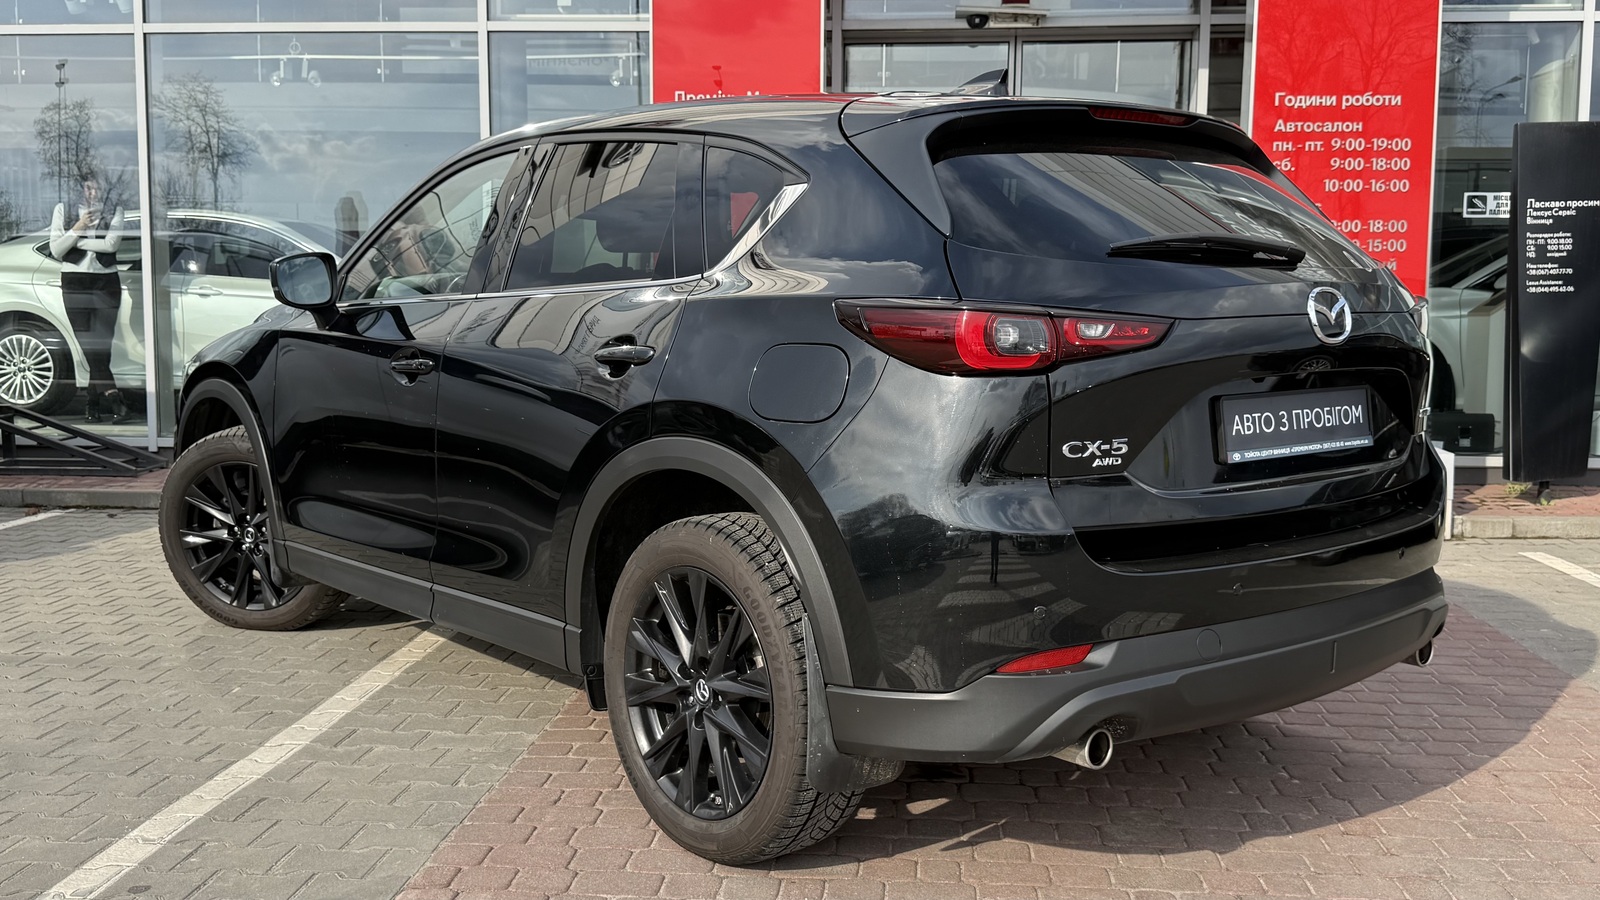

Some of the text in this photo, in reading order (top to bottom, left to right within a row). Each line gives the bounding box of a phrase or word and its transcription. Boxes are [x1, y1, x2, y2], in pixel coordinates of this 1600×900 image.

[1274, 92, 1402, 110] Години роботи
[1274, 119, 1363, 132] Автосалон
[1331, 138, 1412, 151] 9:00-19:00
[1330, 157, 1411, 171] 9:00-18:00
[1323, 179, 1410, 192] 10:00-16:00
[1527, 198, 1566, 209] Ласкаво
[1232, 412, 1276, 436] АВТО
[1292, 404, 1363, 430] ПРОБІГОМ
[1062, 438, 1129, 458] CX-5
[1092, 457, 1122, 467] AWD
